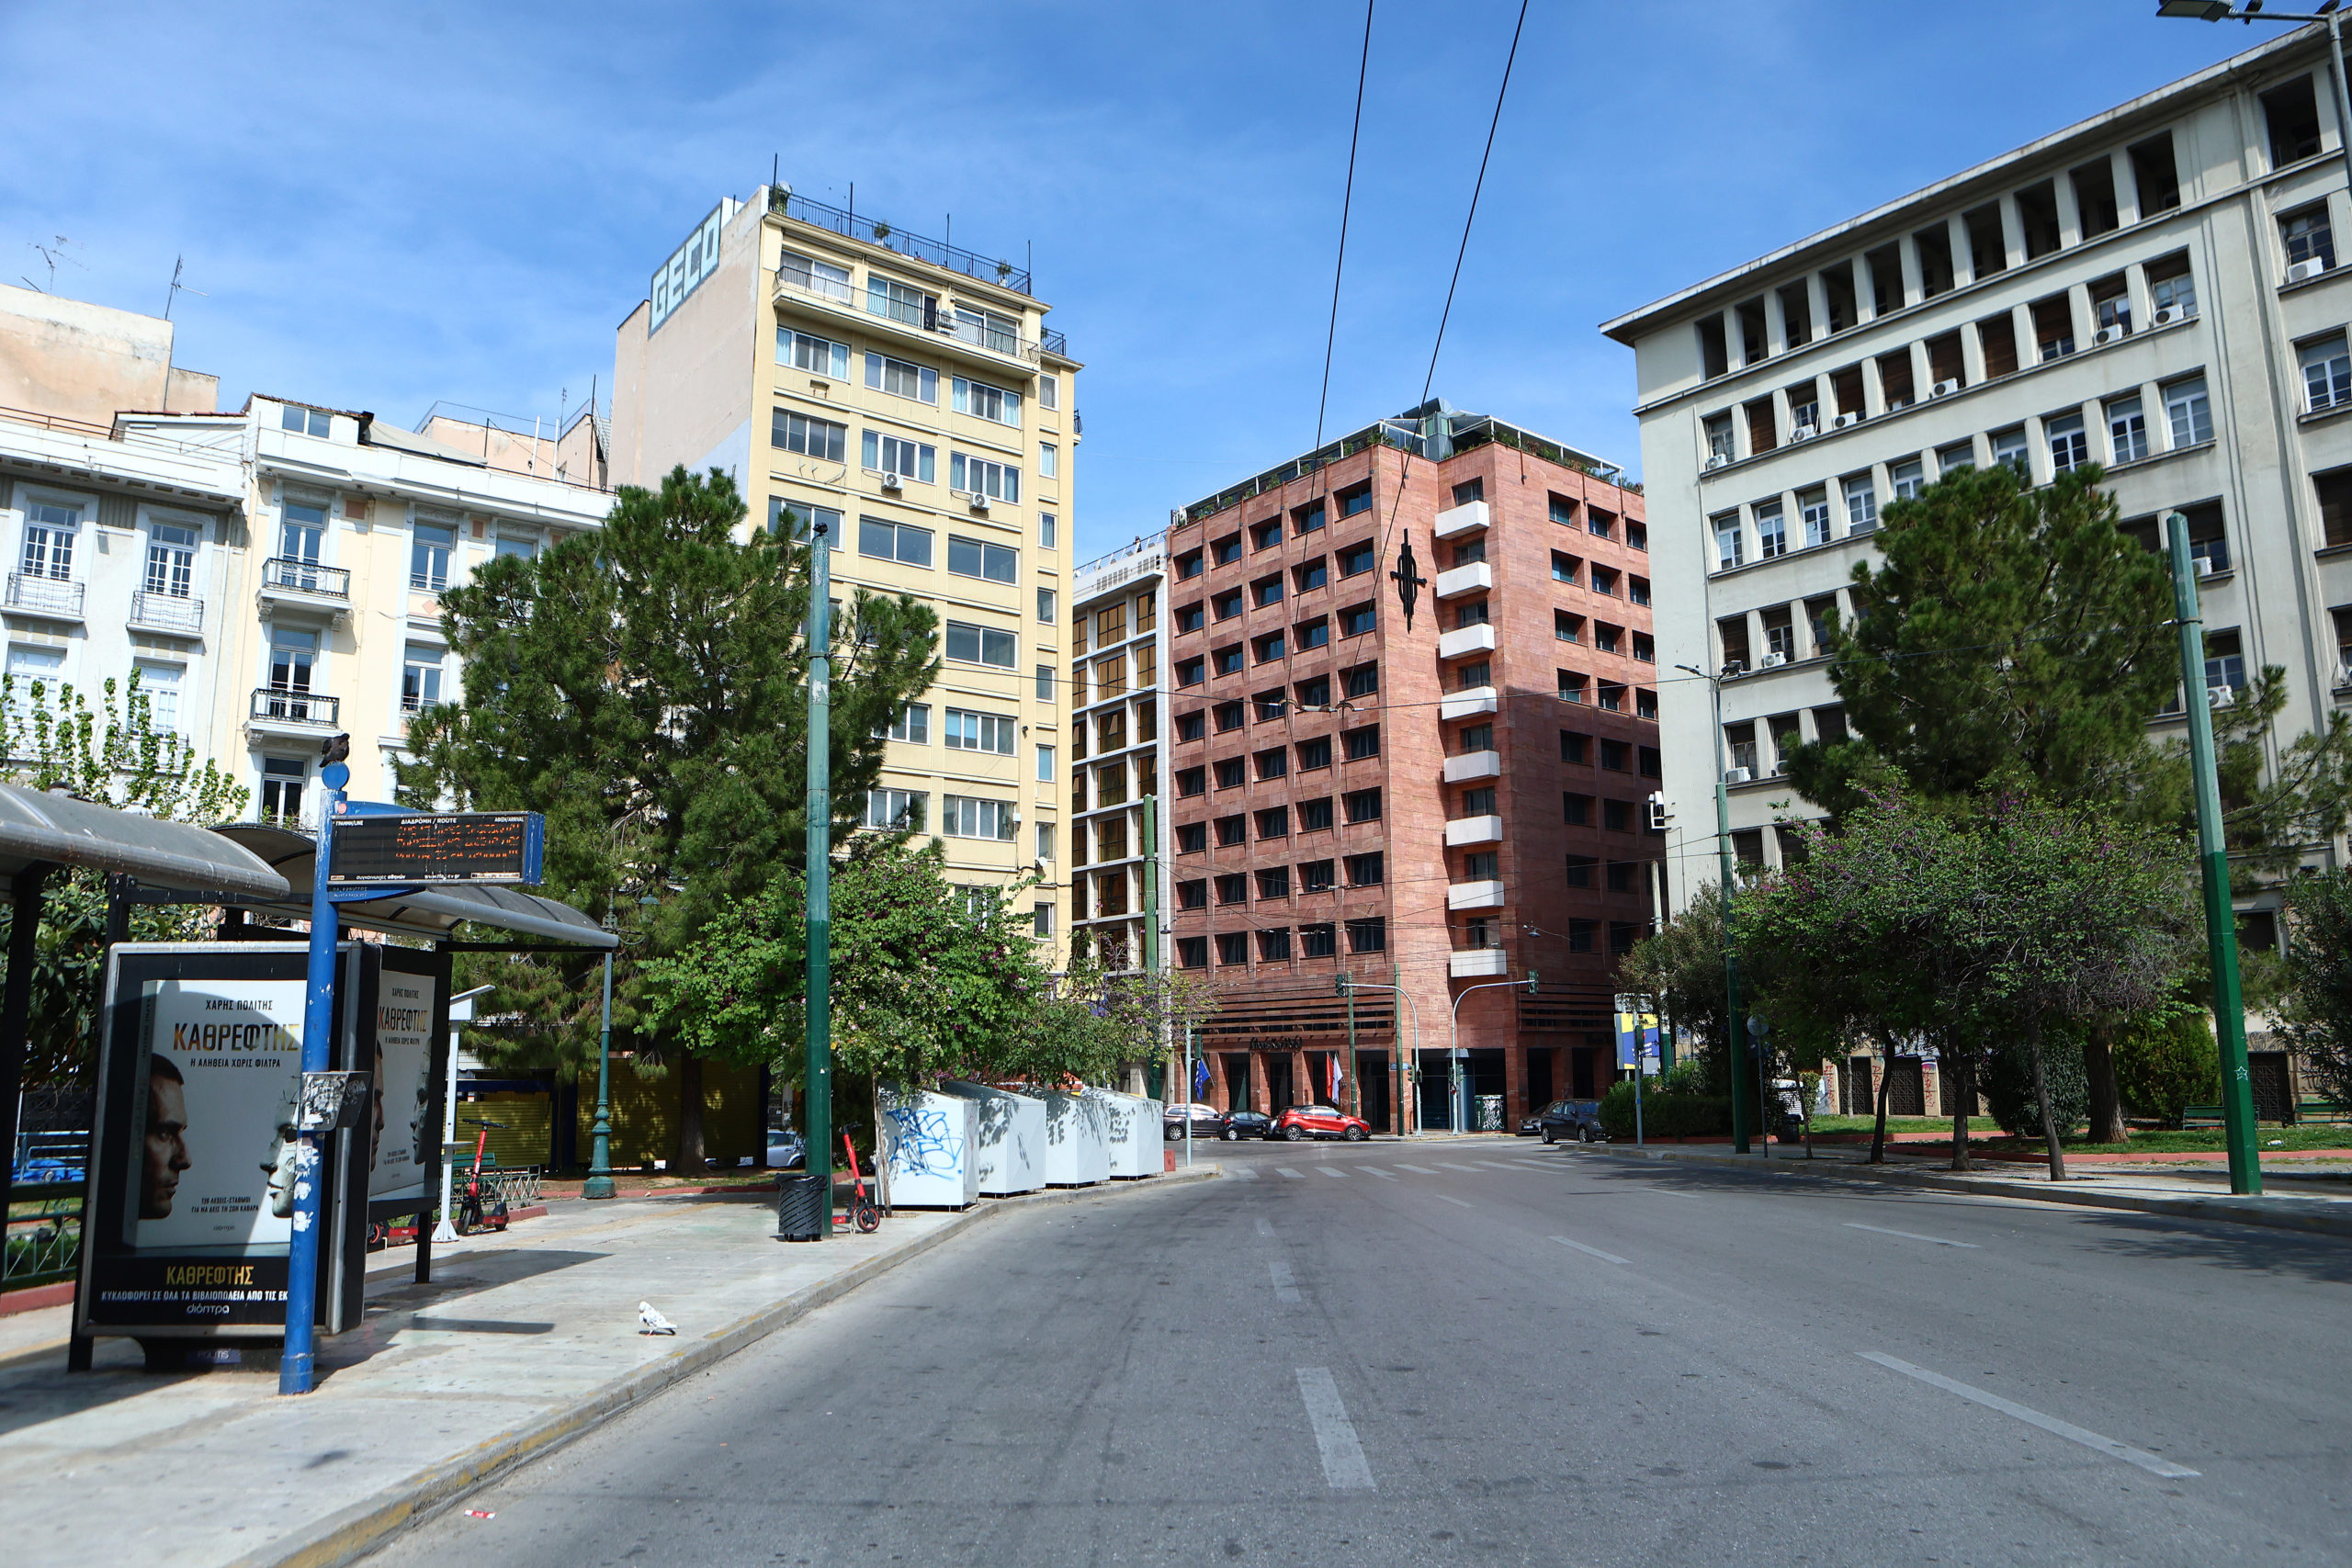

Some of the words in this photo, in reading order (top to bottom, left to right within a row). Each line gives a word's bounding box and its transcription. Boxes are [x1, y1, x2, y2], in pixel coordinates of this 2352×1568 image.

[650, 208, 721, 332] GECO
[205, 999, 234, 1010] ΧΑΡΗΣ
[236, 999, 273, 1010] ΠΟΛΙΤΗΣ
[379, 1006, 427, 1032] ΚΑΘΡΕΦΤΗΣ
[173, 1023, 300, 1052] ΚΑΘΡΕΦΤΗΣ
[190, 1058, 196, 1067] Η
[198, 1058, 229, 1067] ΑΛΗΘΕΙΑ
[232, 1058, 253, 1067] ΧΩΡΙΣ
[254, 1058, 280, 1068] ΦΙΛΤΡΑ
[166, 1266, 254, 1285] ΚΑΘΡΕΦΤΗΣ
[101, 1291, 151, 1302] ΚΥΚΛΟΦΟΡΕΙ
[152, 1291, 162, 1302] ΣΕ
[164, 1291, 178, 1302] ΟΛΑ
[181, 1291, 191, 1302] ΤΑ
[192, 1291, 245, 1302] ΒΙΒΛΙΟΠΩΛΕΙΑ
[246, 1291, 263, 1302] ΑΠΟ
[265, 1291, 277, 1302] ΤΙΣ
